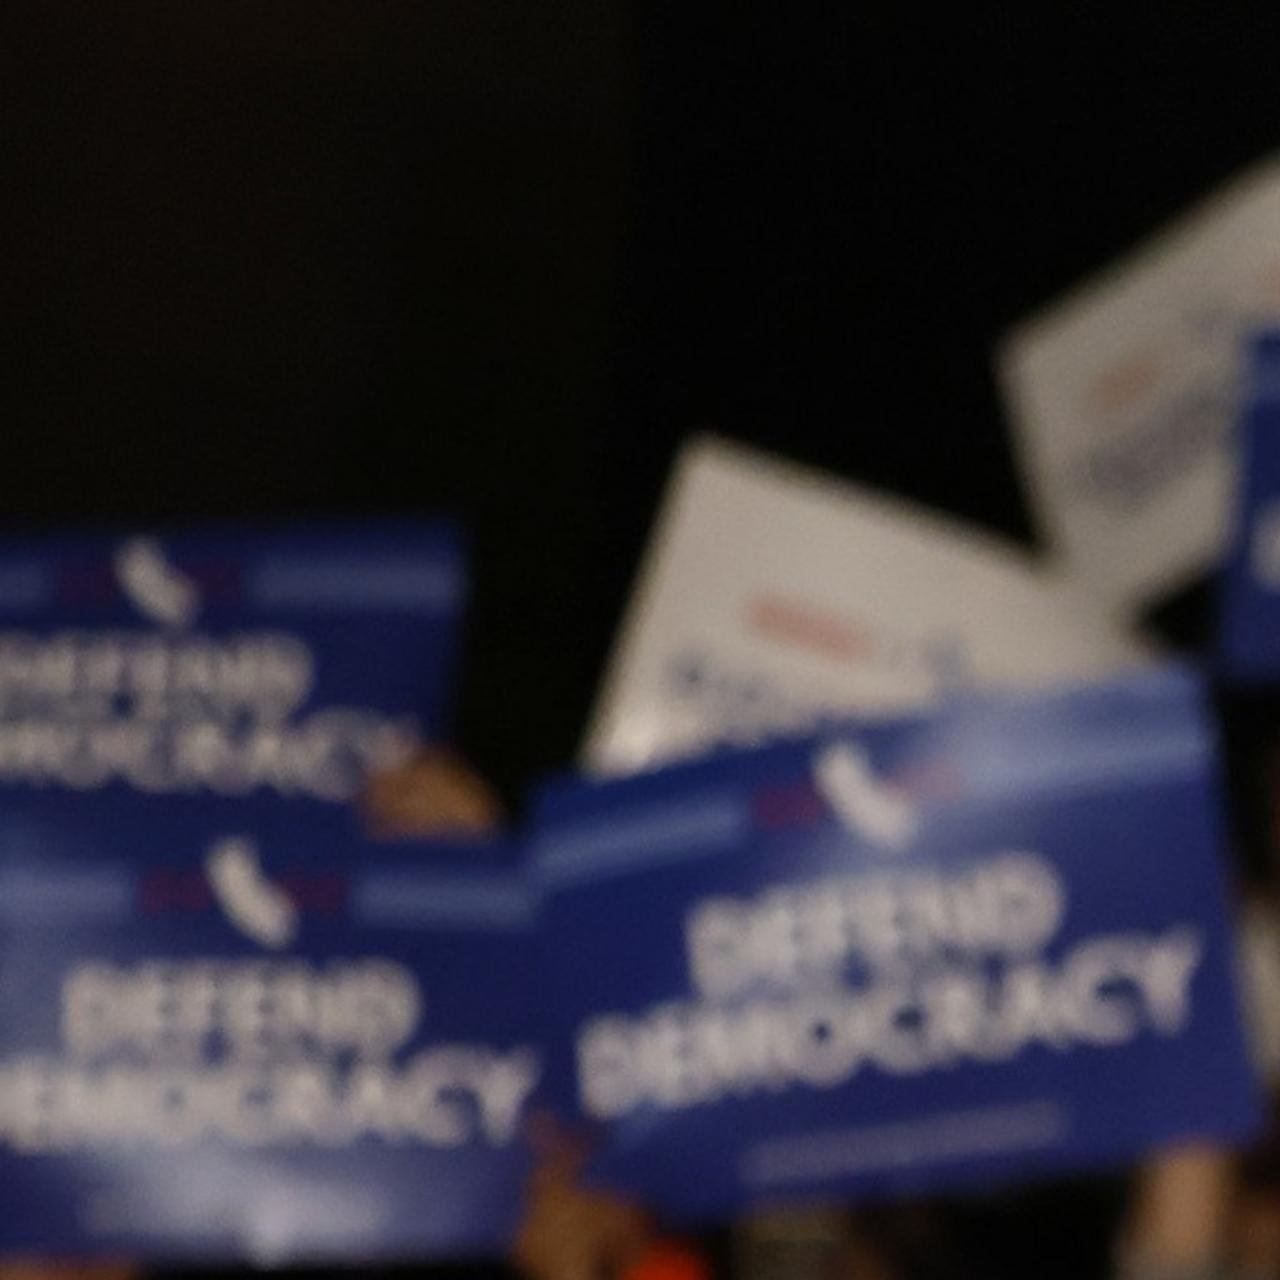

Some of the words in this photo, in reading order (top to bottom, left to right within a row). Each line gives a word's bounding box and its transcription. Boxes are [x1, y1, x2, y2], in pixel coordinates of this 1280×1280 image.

[684, 853, 1065, 996] DEFEND
[61, 957, 421, 1050] DEFEND
[577, 926, 1198, 1118] DEMOCRACY
